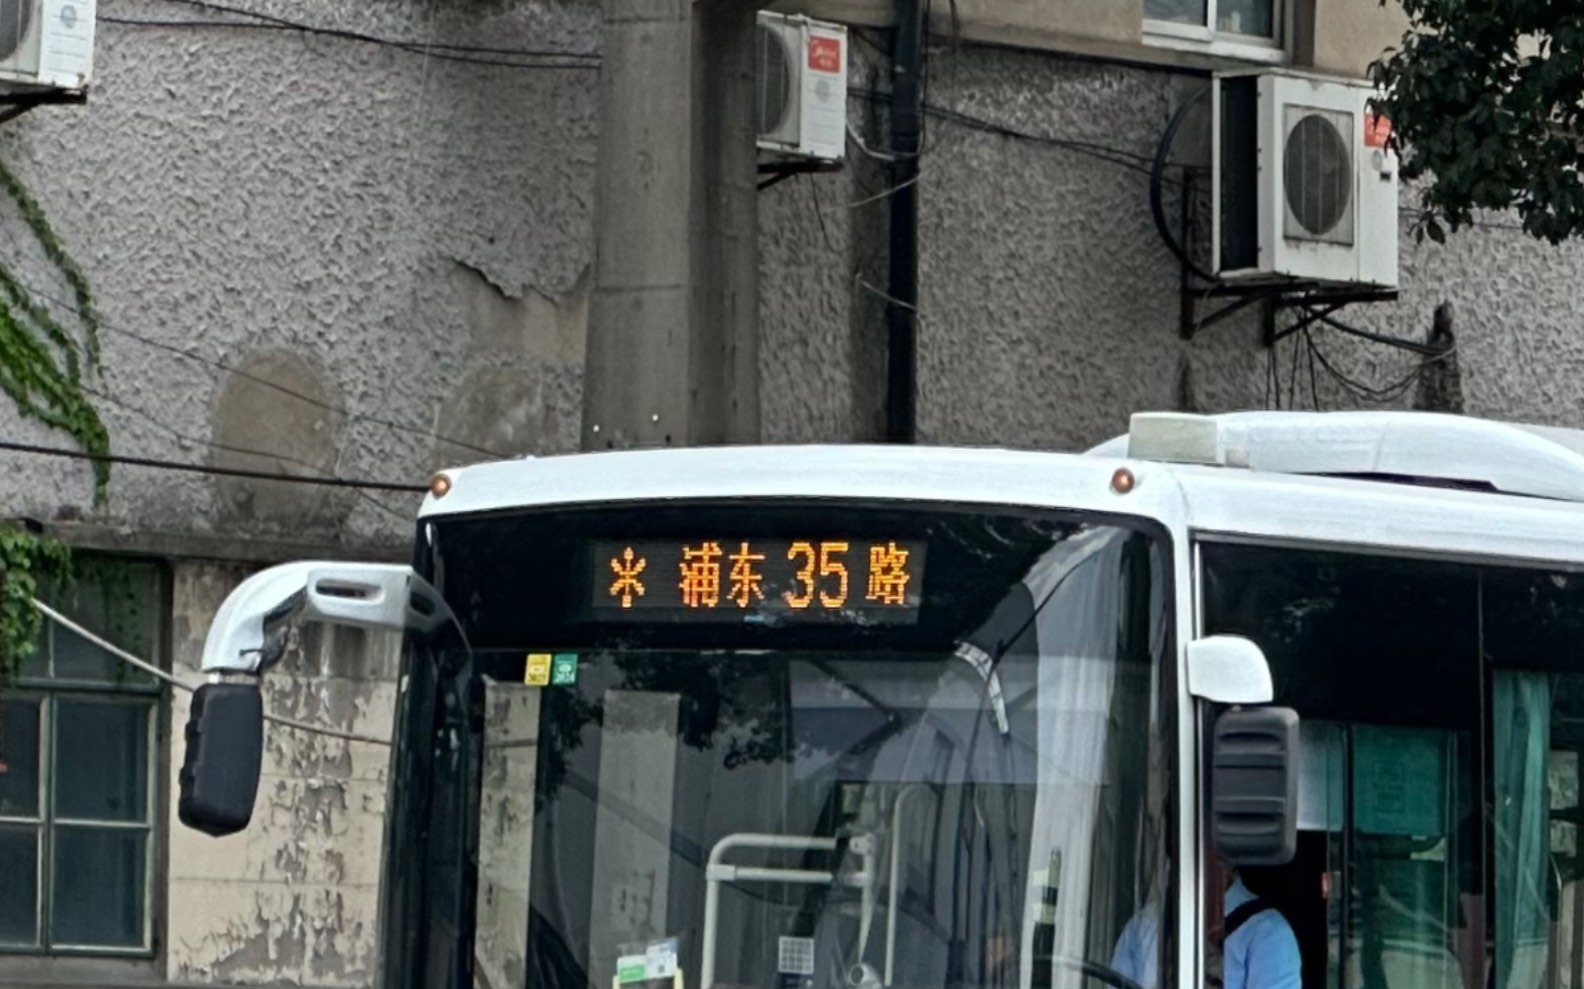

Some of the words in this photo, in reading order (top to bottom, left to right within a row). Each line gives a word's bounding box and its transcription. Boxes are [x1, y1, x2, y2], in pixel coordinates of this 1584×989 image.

[680, 542, 765, 607] 浦东
[784, 542, 849, 608] 35
[866, 542, 910, 605] 路
